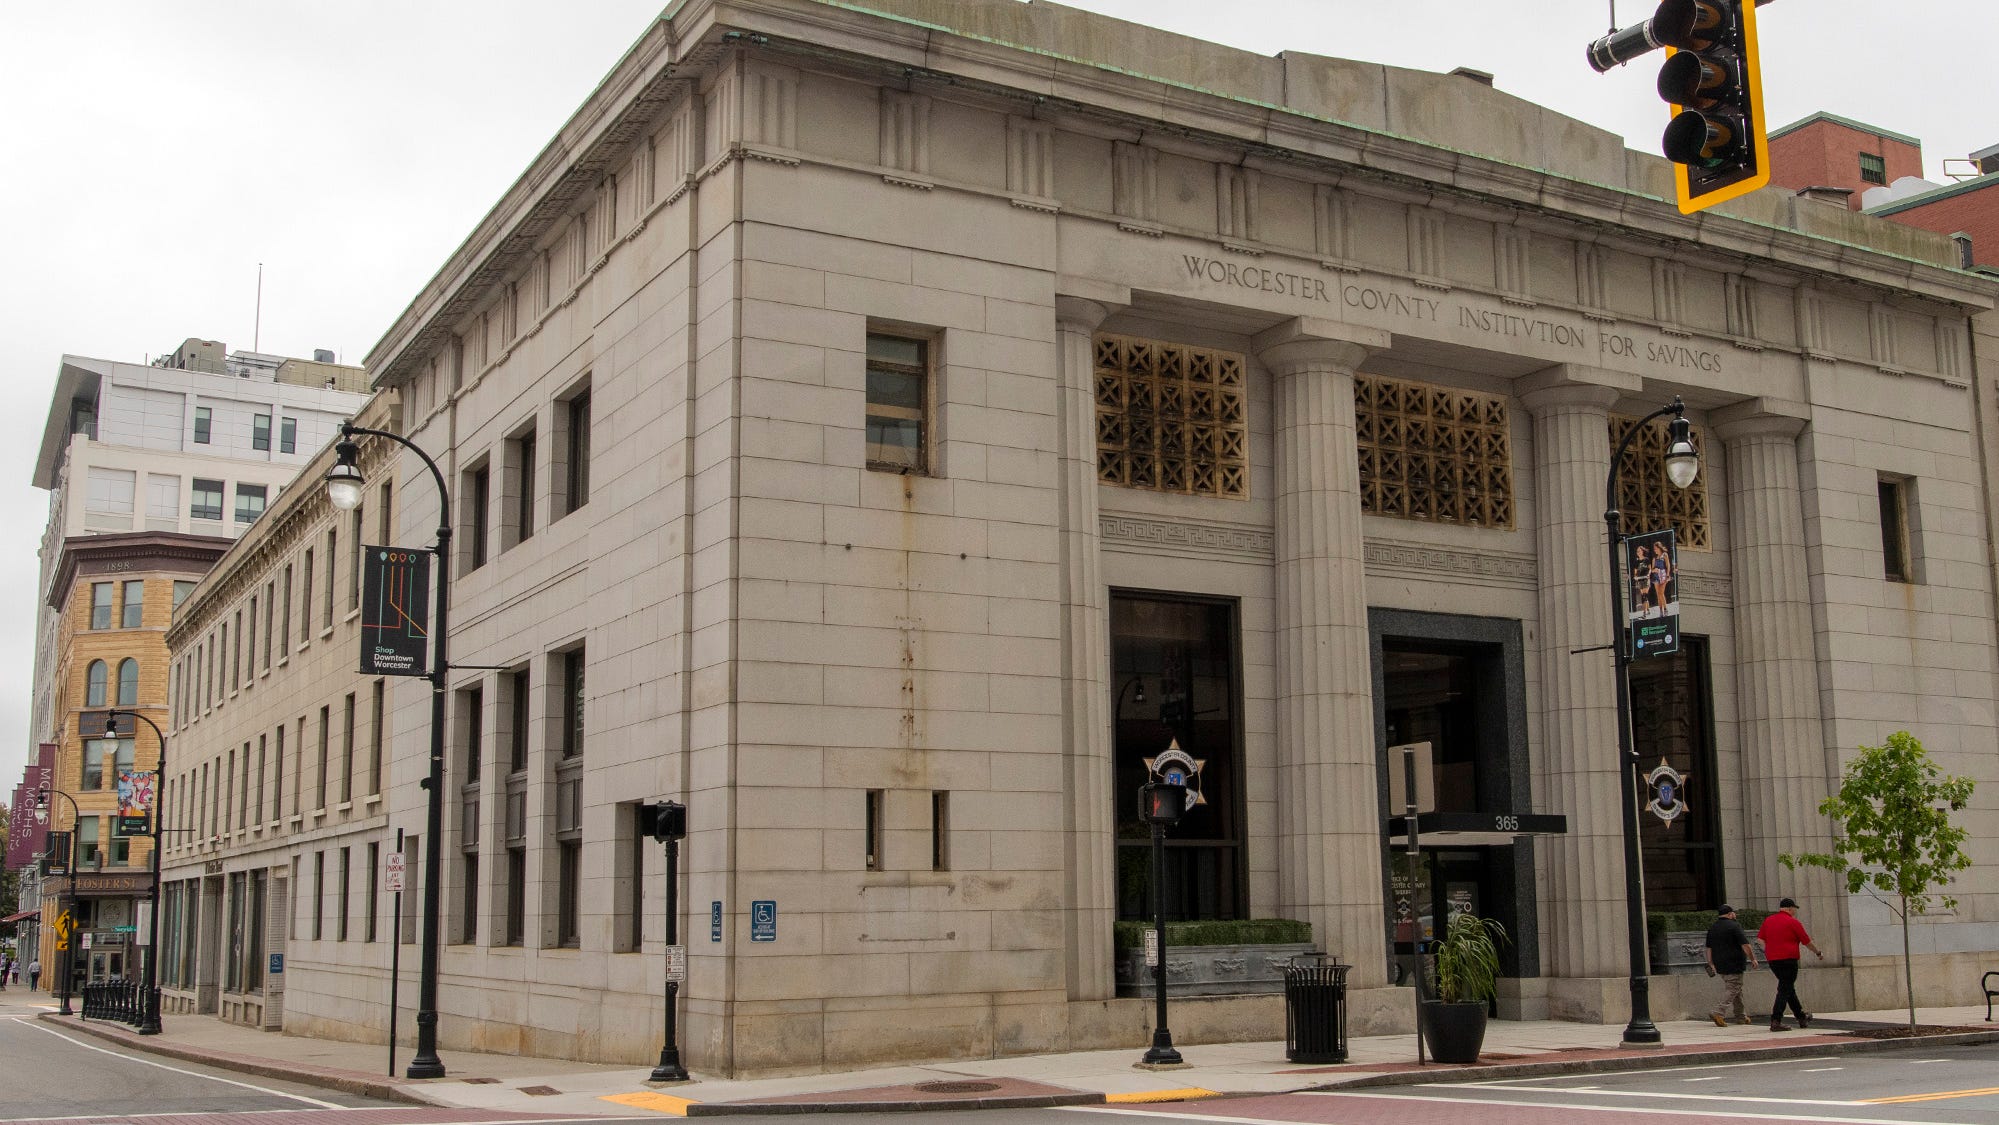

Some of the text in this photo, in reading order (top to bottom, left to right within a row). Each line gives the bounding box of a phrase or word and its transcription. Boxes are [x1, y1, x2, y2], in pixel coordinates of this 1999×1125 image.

[1183, 254, 1721, 373] WORCESTER COVNTY INSTITVTION FOR SAVINGS
[375, 645, 394, 655] Shop
[374, 653, 414, 662] Downtown
[374, 660, 411, 669] Worcester
[37, 768, 52, 825] MCPS
[22, 787, 36, 838] MCPHS
[1495, 815, 1519, 831] 365
[391, 855, 400, 865] NO
[77, 879, 120, 889] FOSTER
[123, 879, 136, 889] ST
